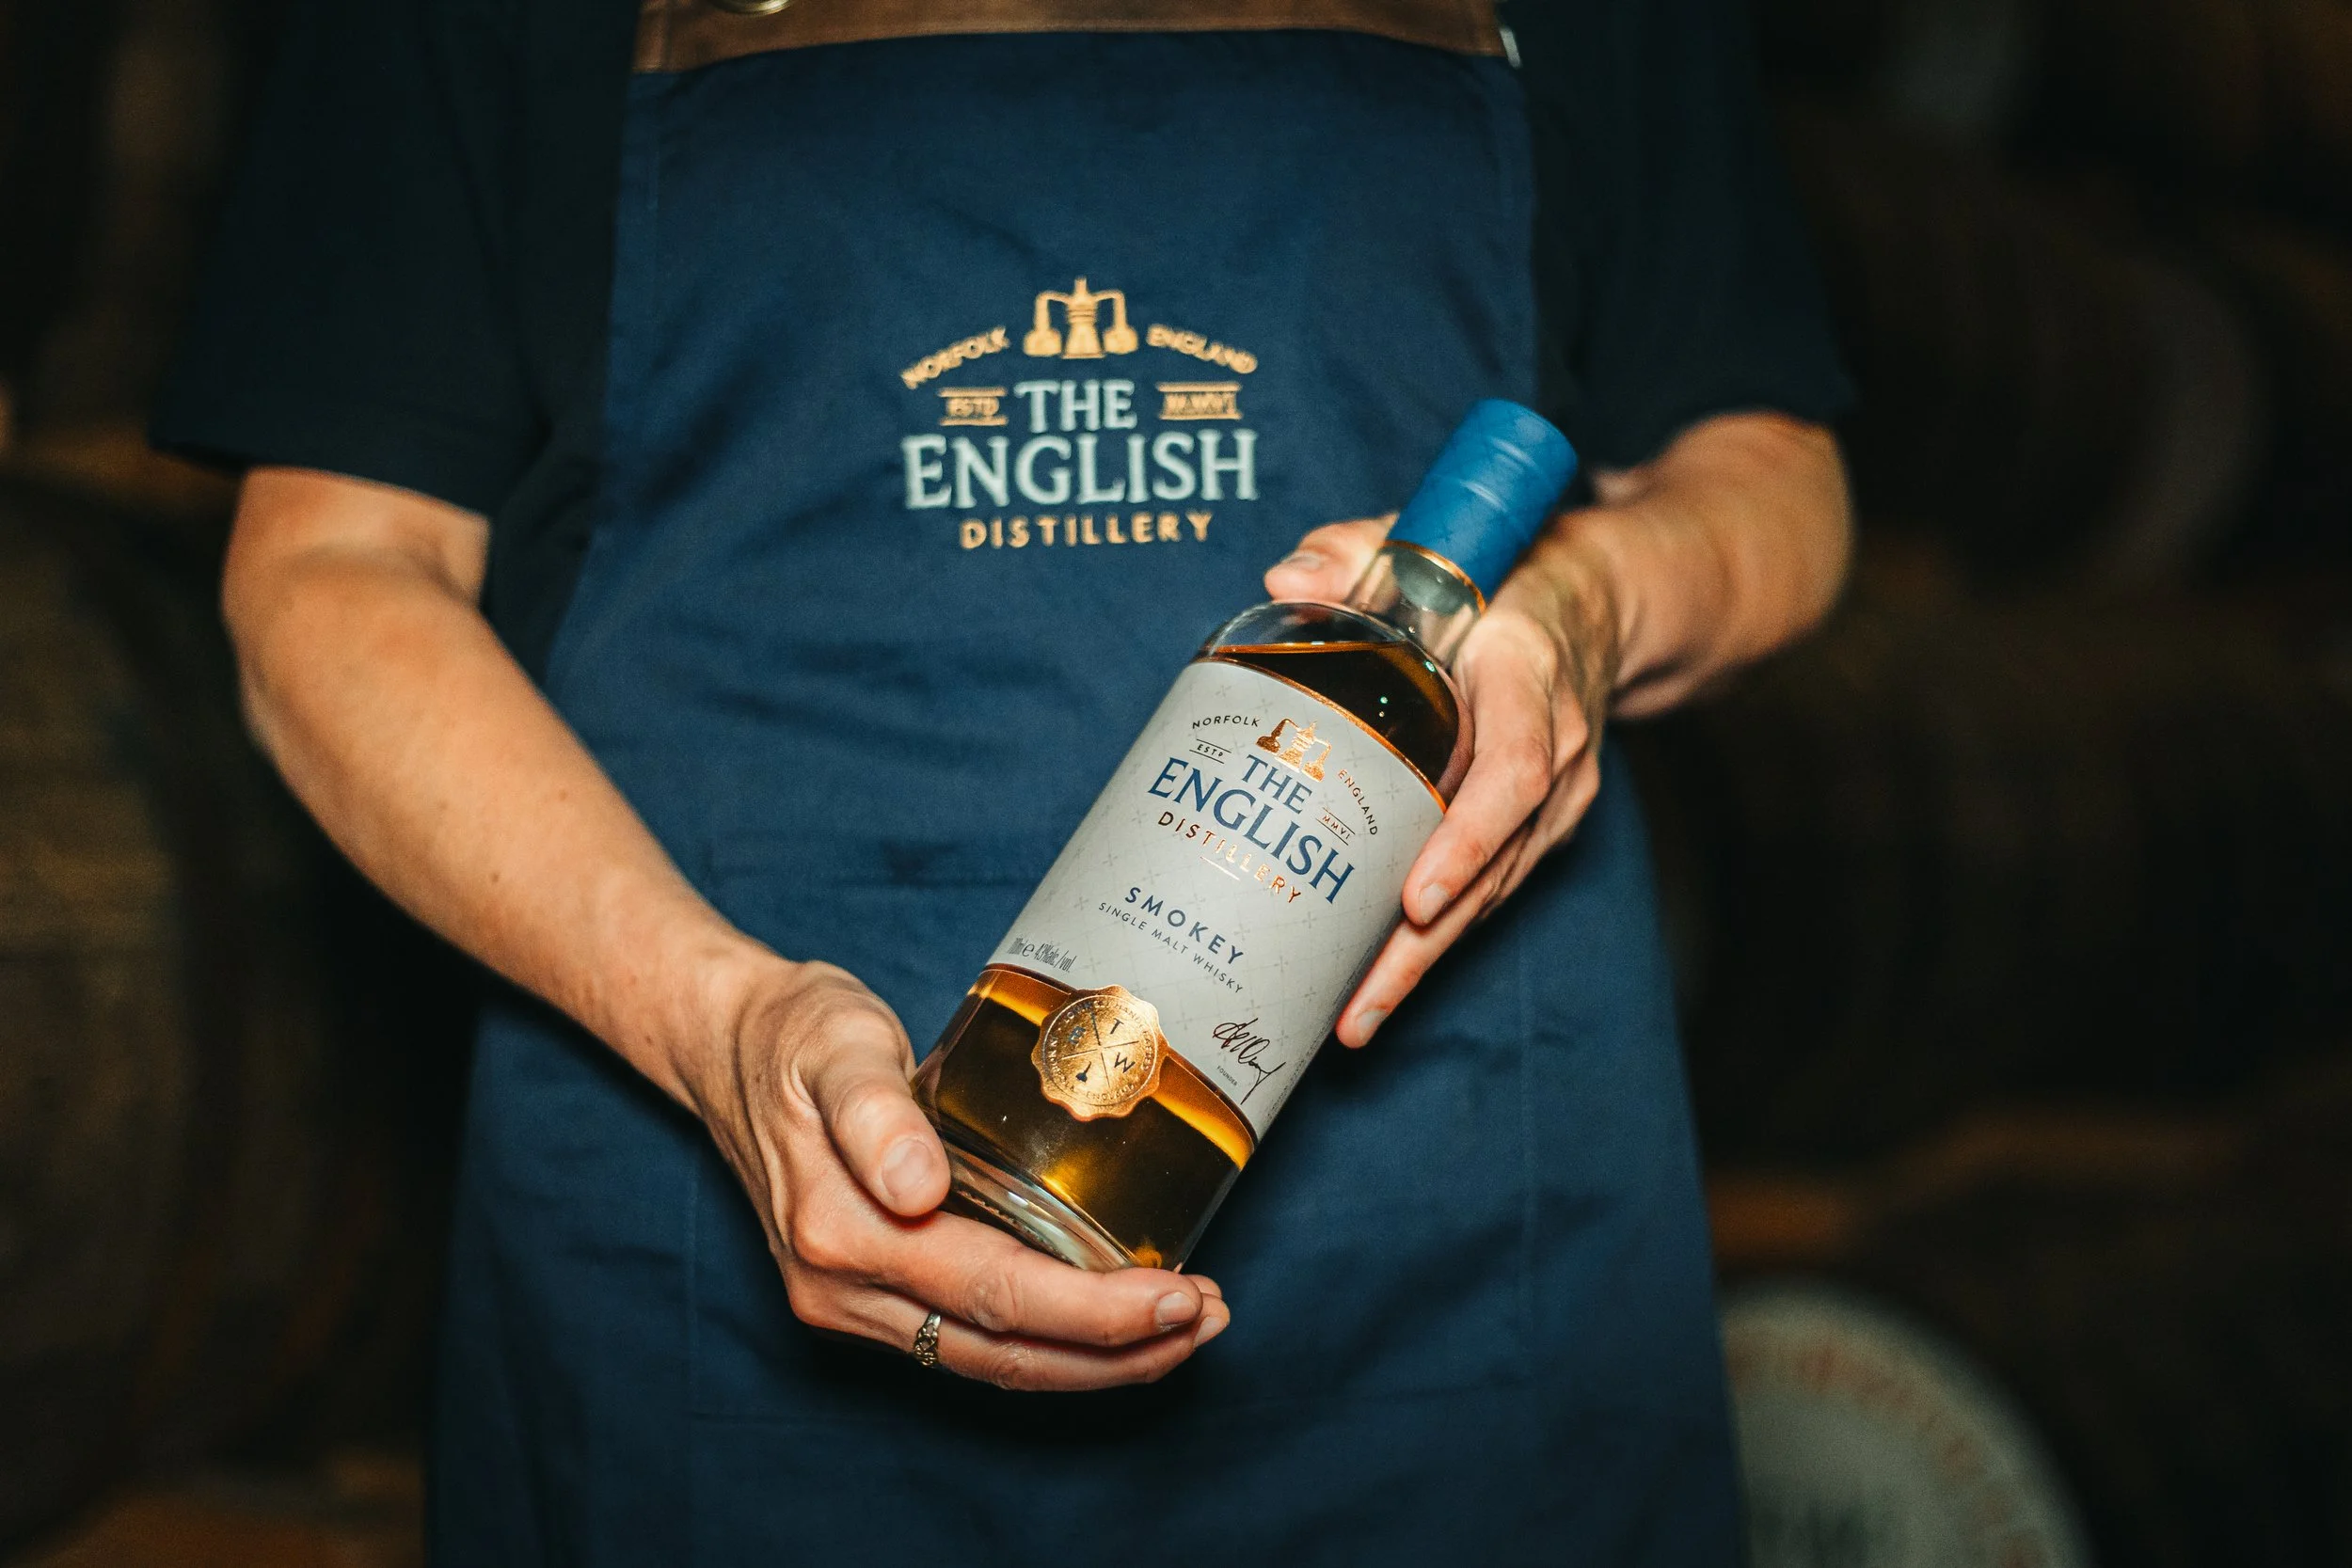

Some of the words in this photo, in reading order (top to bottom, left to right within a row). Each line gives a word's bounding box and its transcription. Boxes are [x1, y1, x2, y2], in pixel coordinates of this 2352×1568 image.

[900, 325, 1009, 389] NORFOLK
[1147, 325, 1257, 373] ENGLAND
[1014, 379, 1137, 433] THE
[900, 429, 1259, 509] ENGLISH
[960, 511, 1213, 549] DISTILLERY
[1192, 715, 1261, 729] NORFOLK
[1338, 769, 1378, 835] ENGLAND
[1240, 754, 1312, 815] THE
[1147, 756, 1356, 904] ENGLISH
[1157, 811, 1301, 903] DISTILLERY
[1322, 814, 1351, 840] MMVI
[1099, 902, 1147, 930] SINGLE
[1152, 928, 1188, 954] MALT
[1193, 953, 1243, 993] WHISKY
[1124, 886, 1244, 965] SMOKEY
[1110, 1017, 1124, 1035] T
[1114, 1052, 1136, 1073] W
[1216, 1065, 1239, 1086] FOUNDER
